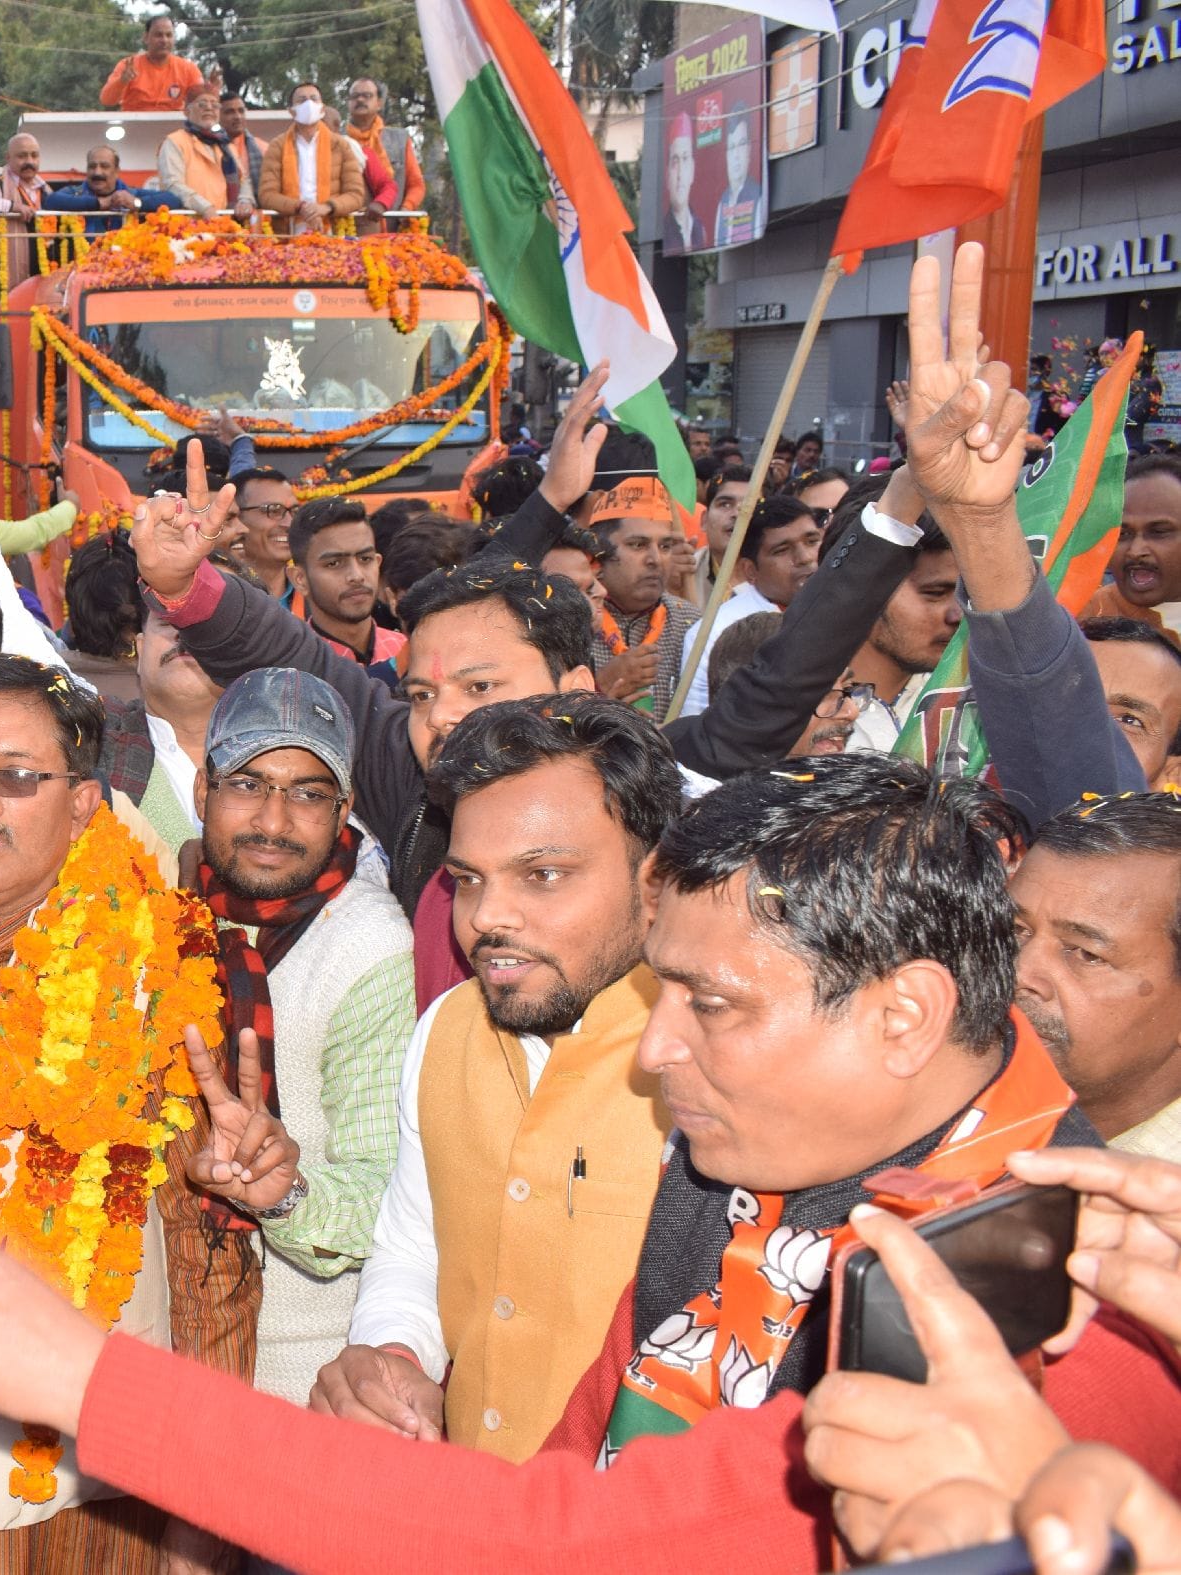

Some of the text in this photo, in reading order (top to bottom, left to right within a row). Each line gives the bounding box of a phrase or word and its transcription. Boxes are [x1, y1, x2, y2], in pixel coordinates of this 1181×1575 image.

[711, 35, 747, 76] 2022
[1036, 233, 1178, 286] FOR ALL
